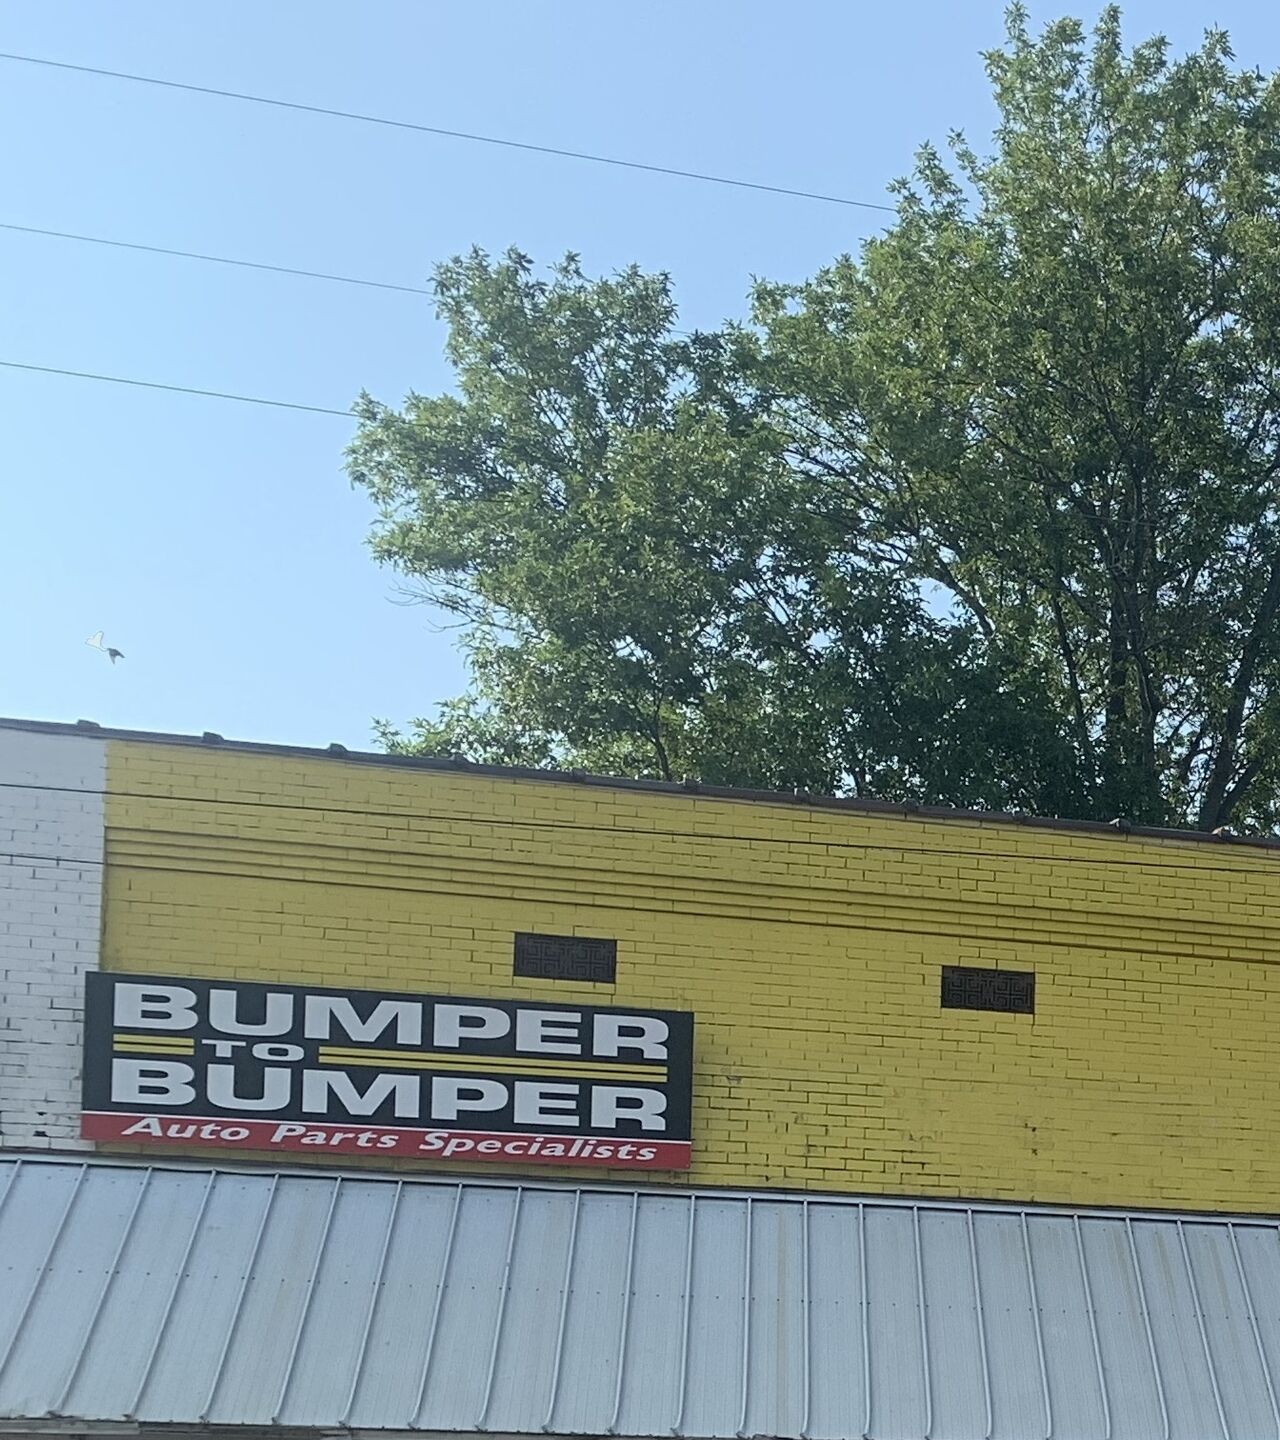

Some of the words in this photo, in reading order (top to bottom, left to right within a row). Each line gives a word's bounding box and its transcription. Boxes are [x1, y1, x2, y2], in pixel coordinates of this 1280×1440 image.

[113, 982, 670, 1060] BUMPER
[202, 1039, 305, 1062] TO
[111, 1057, 668, 1132] BUMPER
[122, 1117, 250, 1143] Auto
[271, 1124, 399, 1149] Parts
[419, 1131, 658, 1161] Specialists
